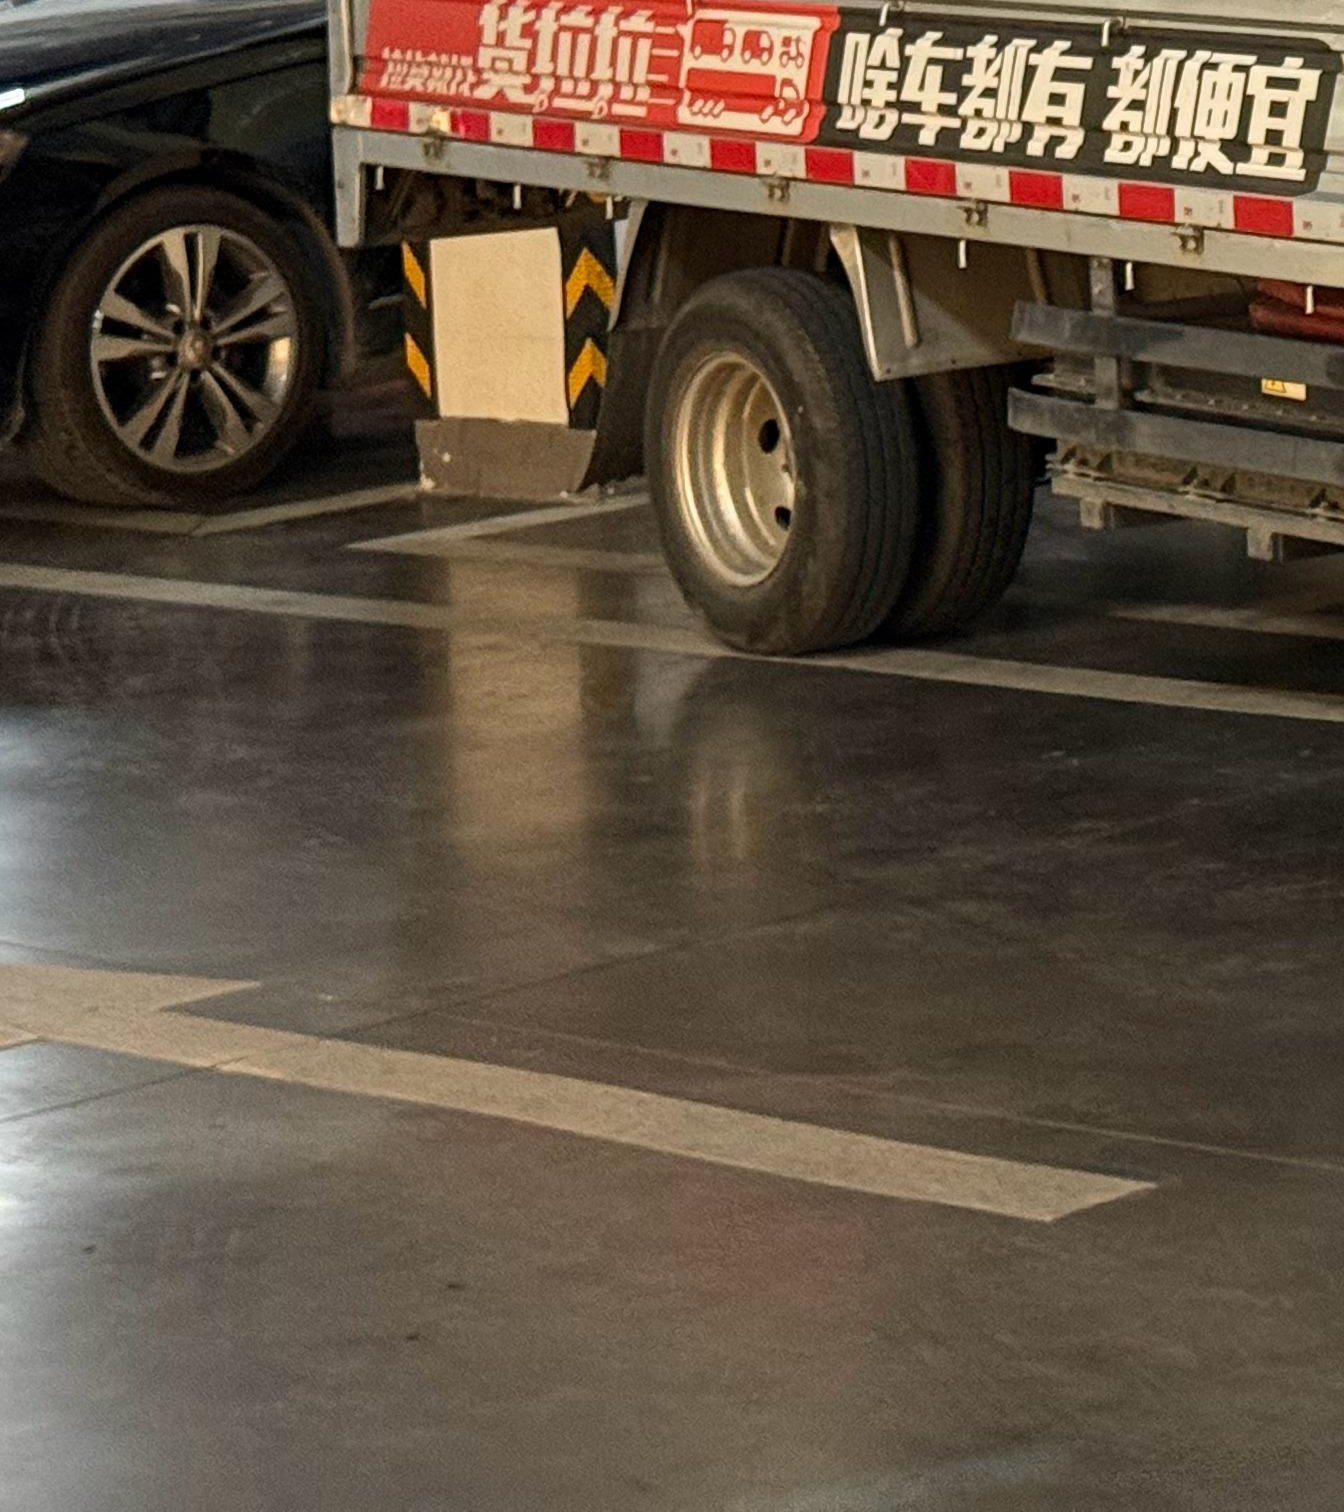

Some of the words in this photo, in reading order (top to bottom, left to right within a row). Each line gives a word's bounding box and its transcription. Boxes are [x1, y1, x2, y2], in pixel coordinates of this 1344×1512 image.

[835, 28, 1094, 160] 啥车都有
[1102, 44, 1323, 182] 都便宜
